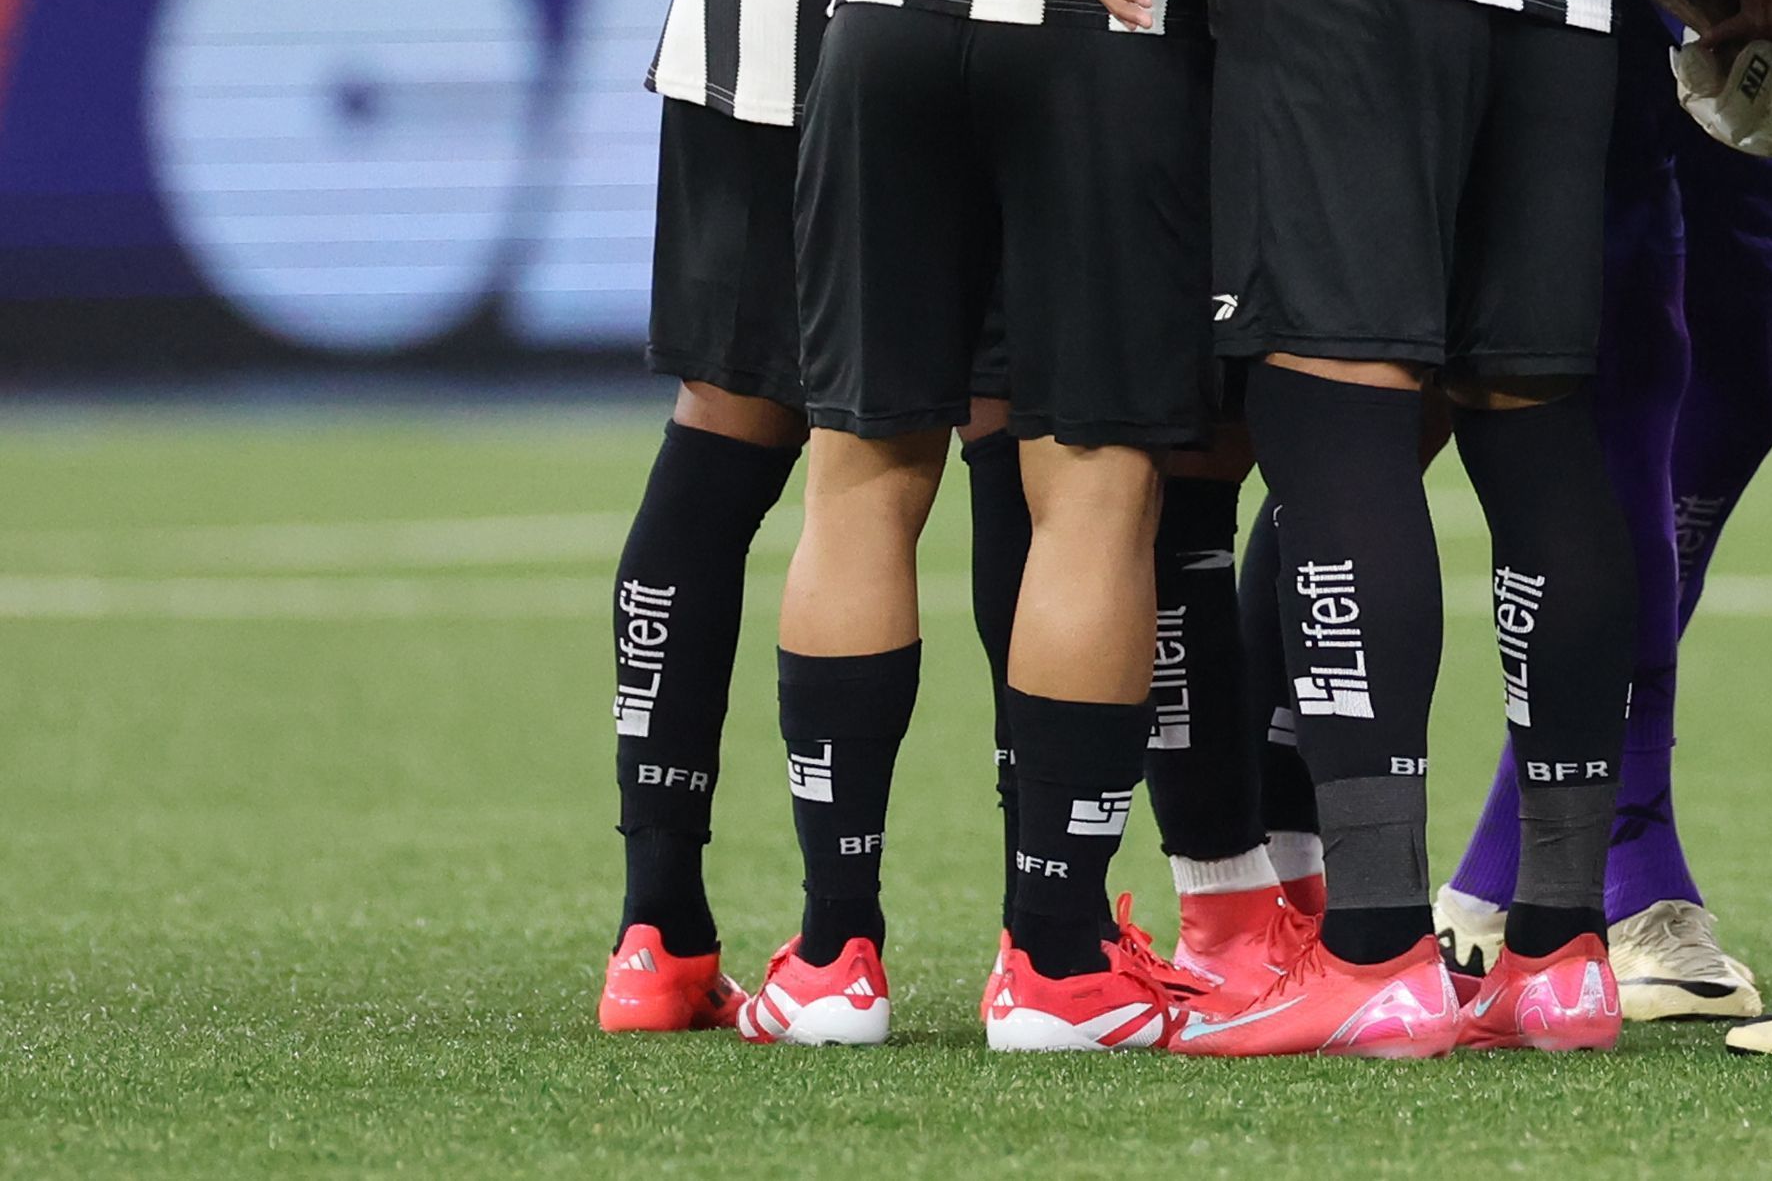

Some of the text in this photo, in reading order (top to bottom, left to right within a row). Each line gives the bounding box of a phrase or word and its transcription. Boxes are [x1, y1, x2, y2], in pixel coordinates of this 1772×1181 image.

[1296, 559, 1367, 678] Lifefit
[619, 579, 677, 696] Lifefit
[637, 764, 709, 794] BFR
[1390, 756, 1429, 776] BF
[1527, 760, 1609, 782] BFR
[839, 832, 884, 856] BF
